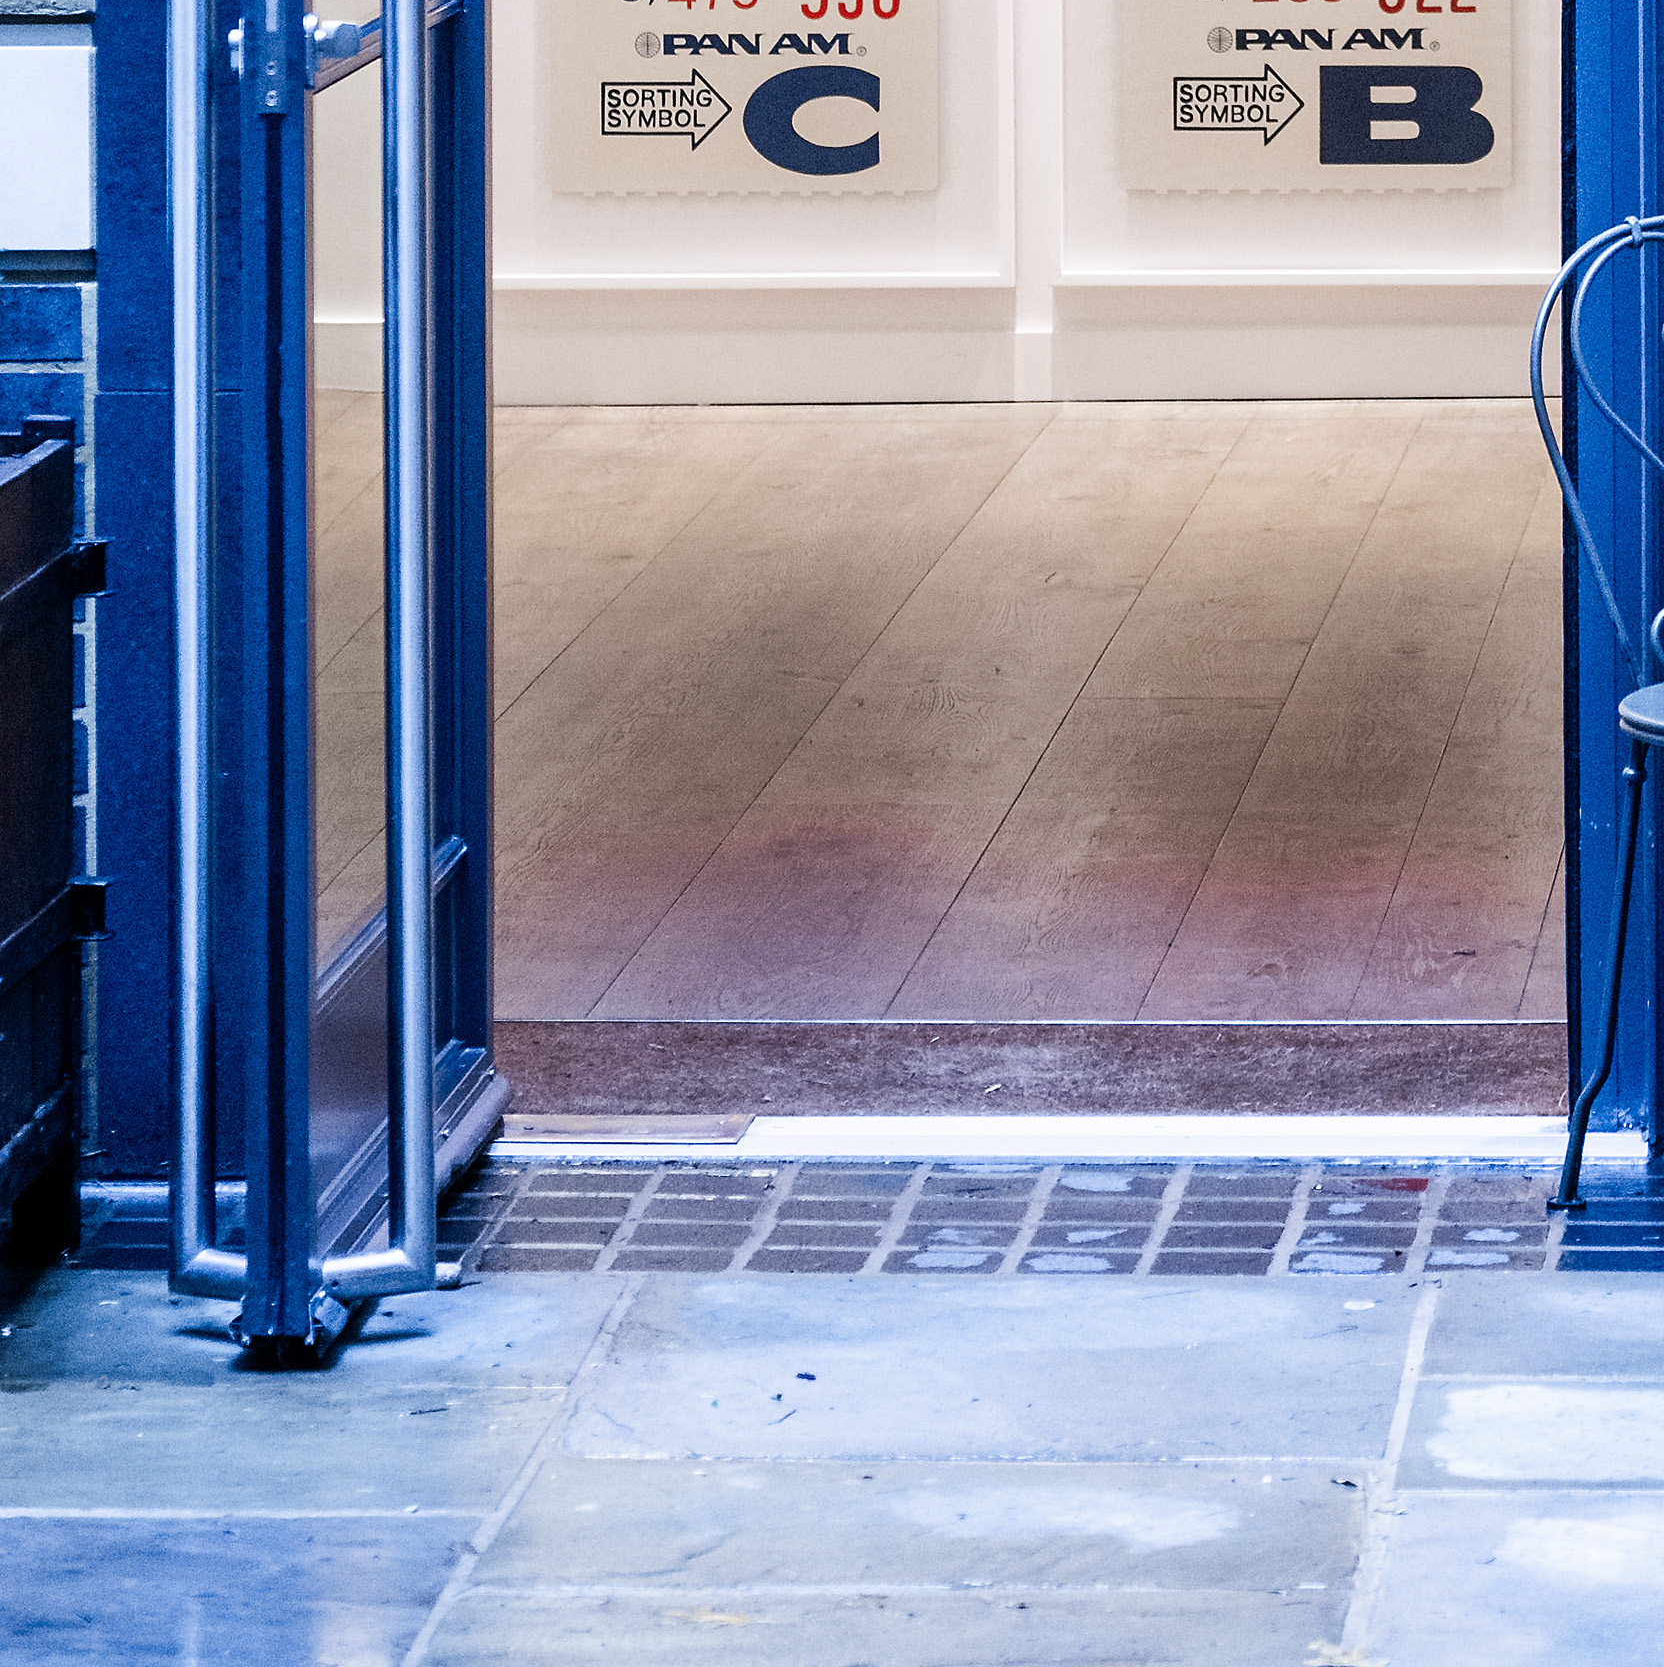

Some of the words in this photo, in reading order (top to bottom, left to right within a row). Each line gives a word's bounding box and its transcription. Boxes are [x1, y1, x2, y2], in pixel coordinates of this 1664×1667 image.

[662, 33, 763, 56] PAN
[768, 32, 852, 56] AM
[1235, 28, 1336, 51] PAN
[1341, 27, 1425, 51] AM
[607, 87, 713, 109] SORTING
[1179, 82, 1286, 104] SORTING
[607, 108, 706, 129] SYMBOL
[742, 64, 881, 176] C
[1179, 103, 1278, 124] SYMBOL
[1319, 64, 1495, 166] B
